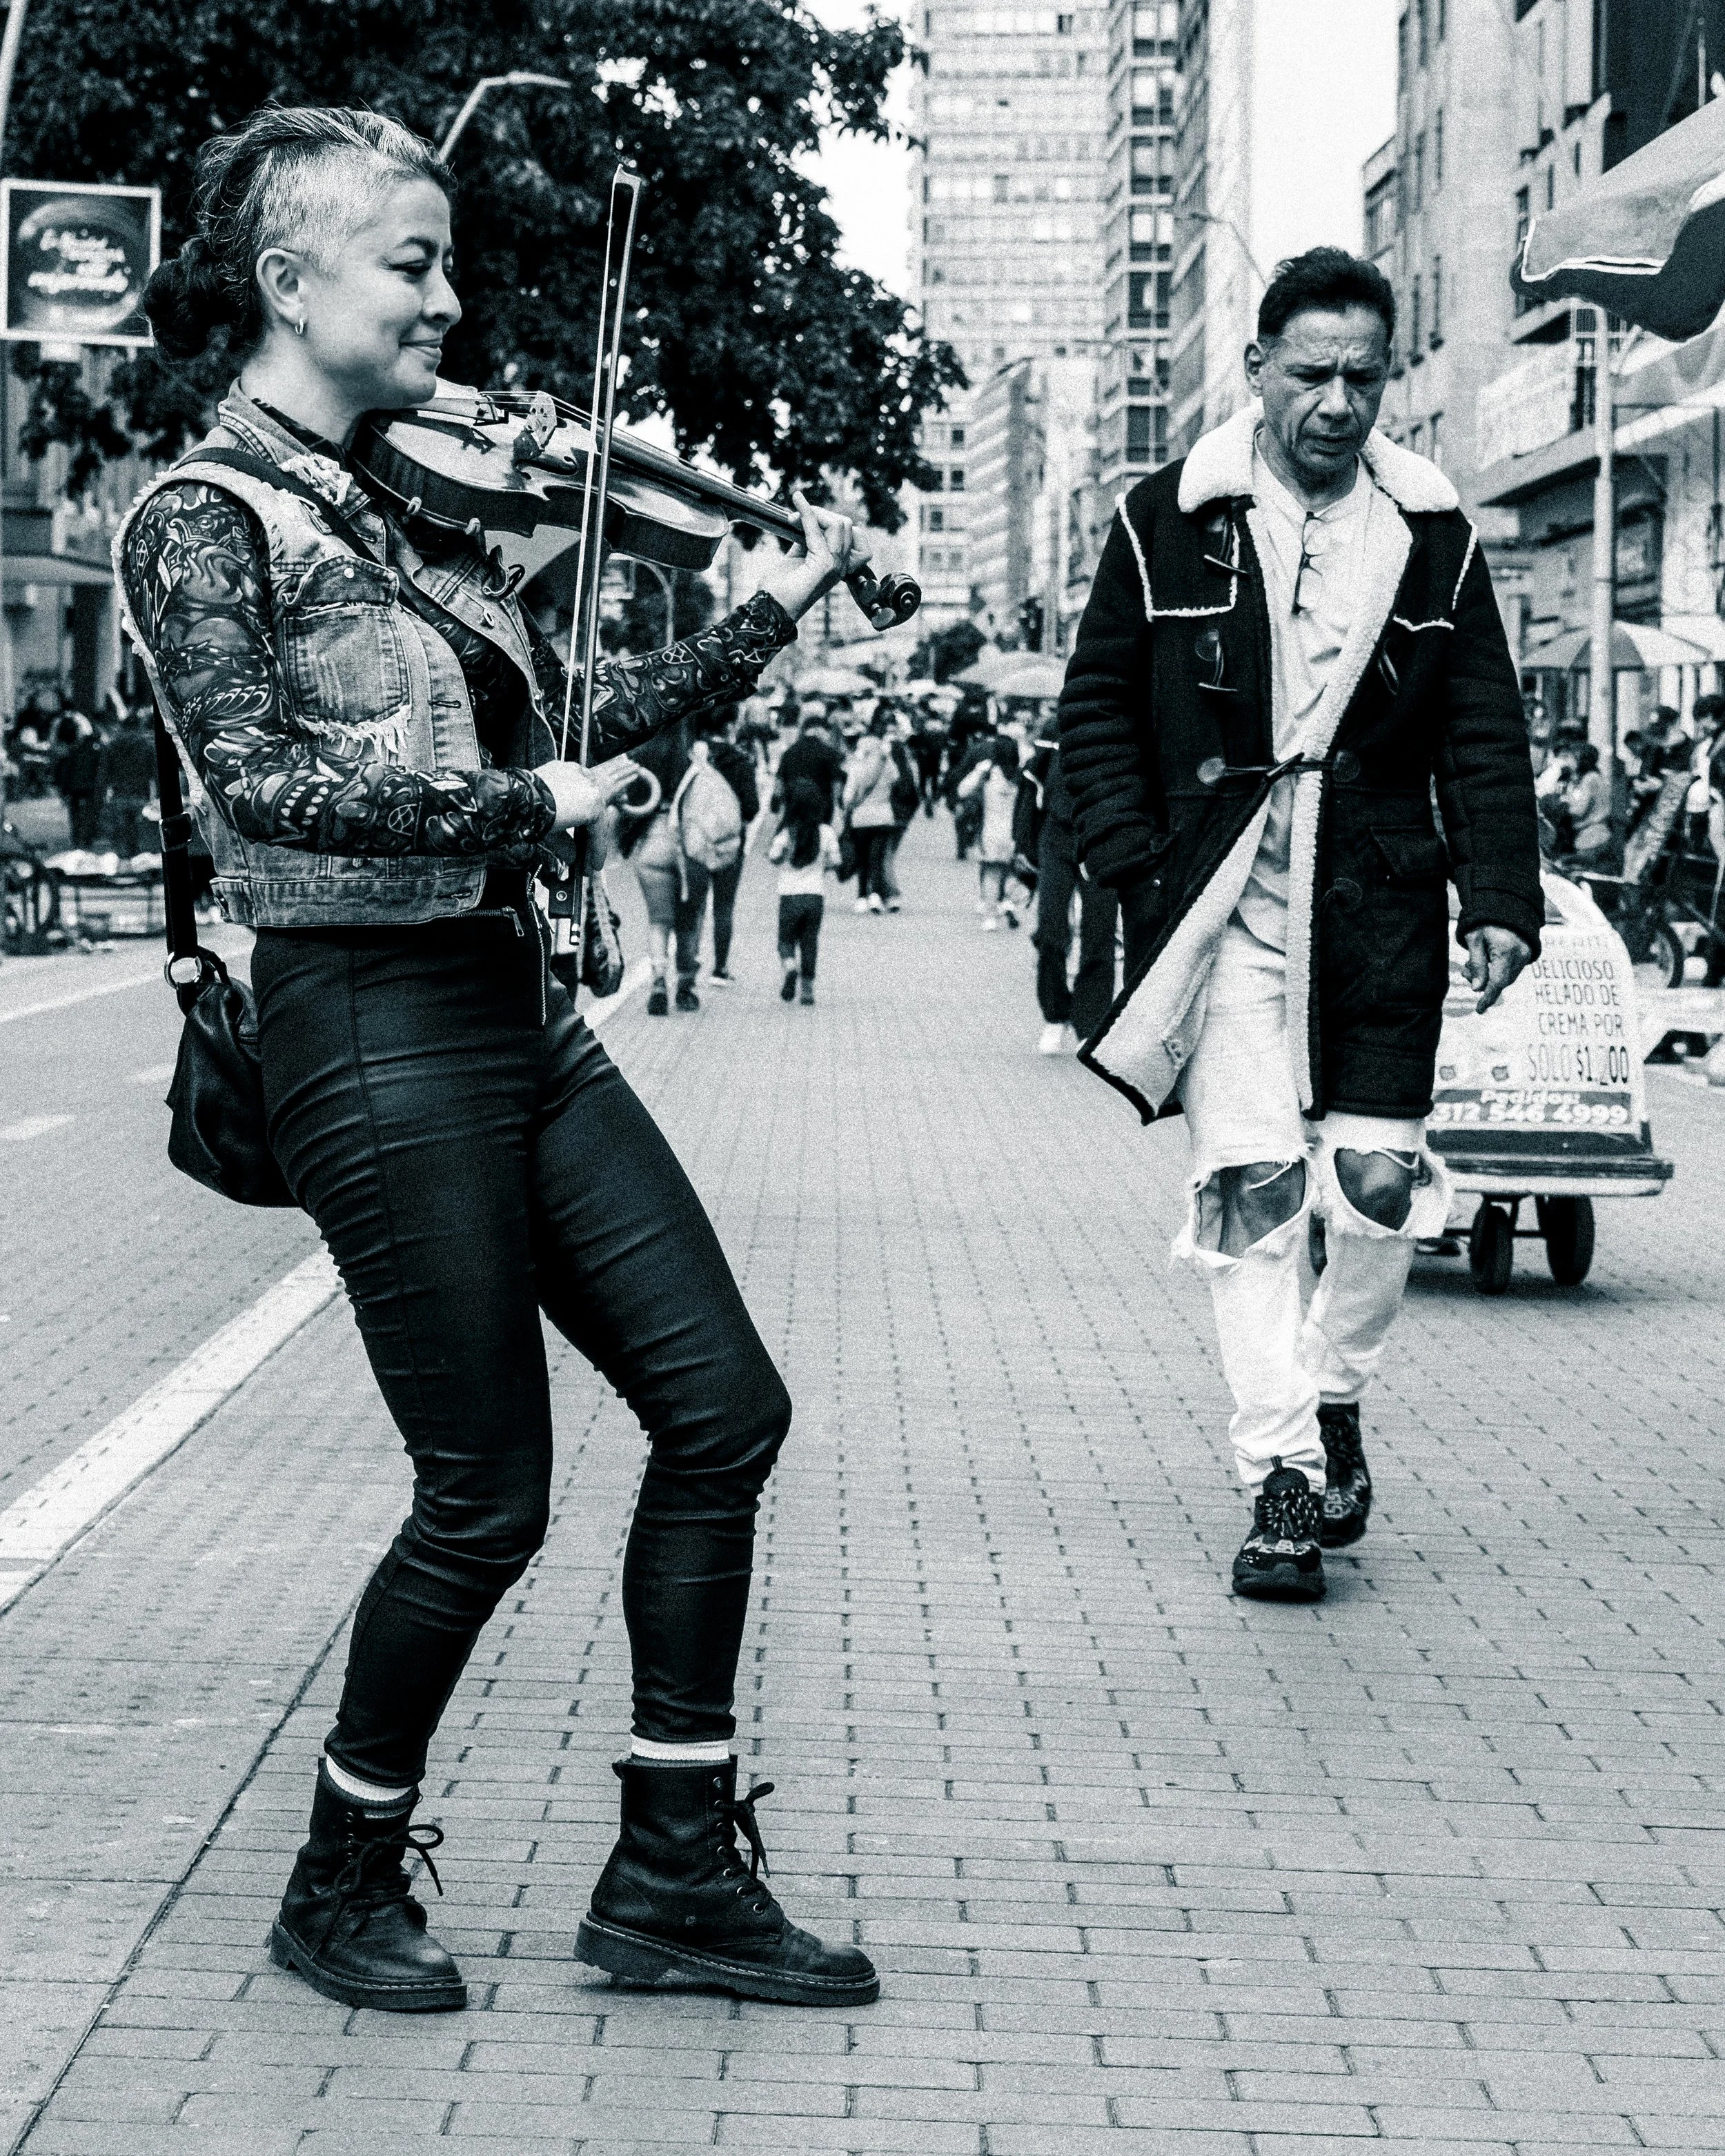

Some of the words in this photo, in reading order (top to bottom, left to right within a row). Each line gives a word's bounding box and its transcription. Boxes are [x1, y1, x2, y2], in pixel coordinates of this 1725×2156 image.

[1535, 984, 1595, 1006] HELADO
[1599, 984, 1621, 1007] DE
[1538, 1012, 1588, 1036] CREMA
[1594, 1013, 1625, 1036] POR
[1527, 1042, 1570, 1082] SOLO
[1487, 1104, 1546, 1123] 546
[1552, 1105, 1628, 1125] 4999
